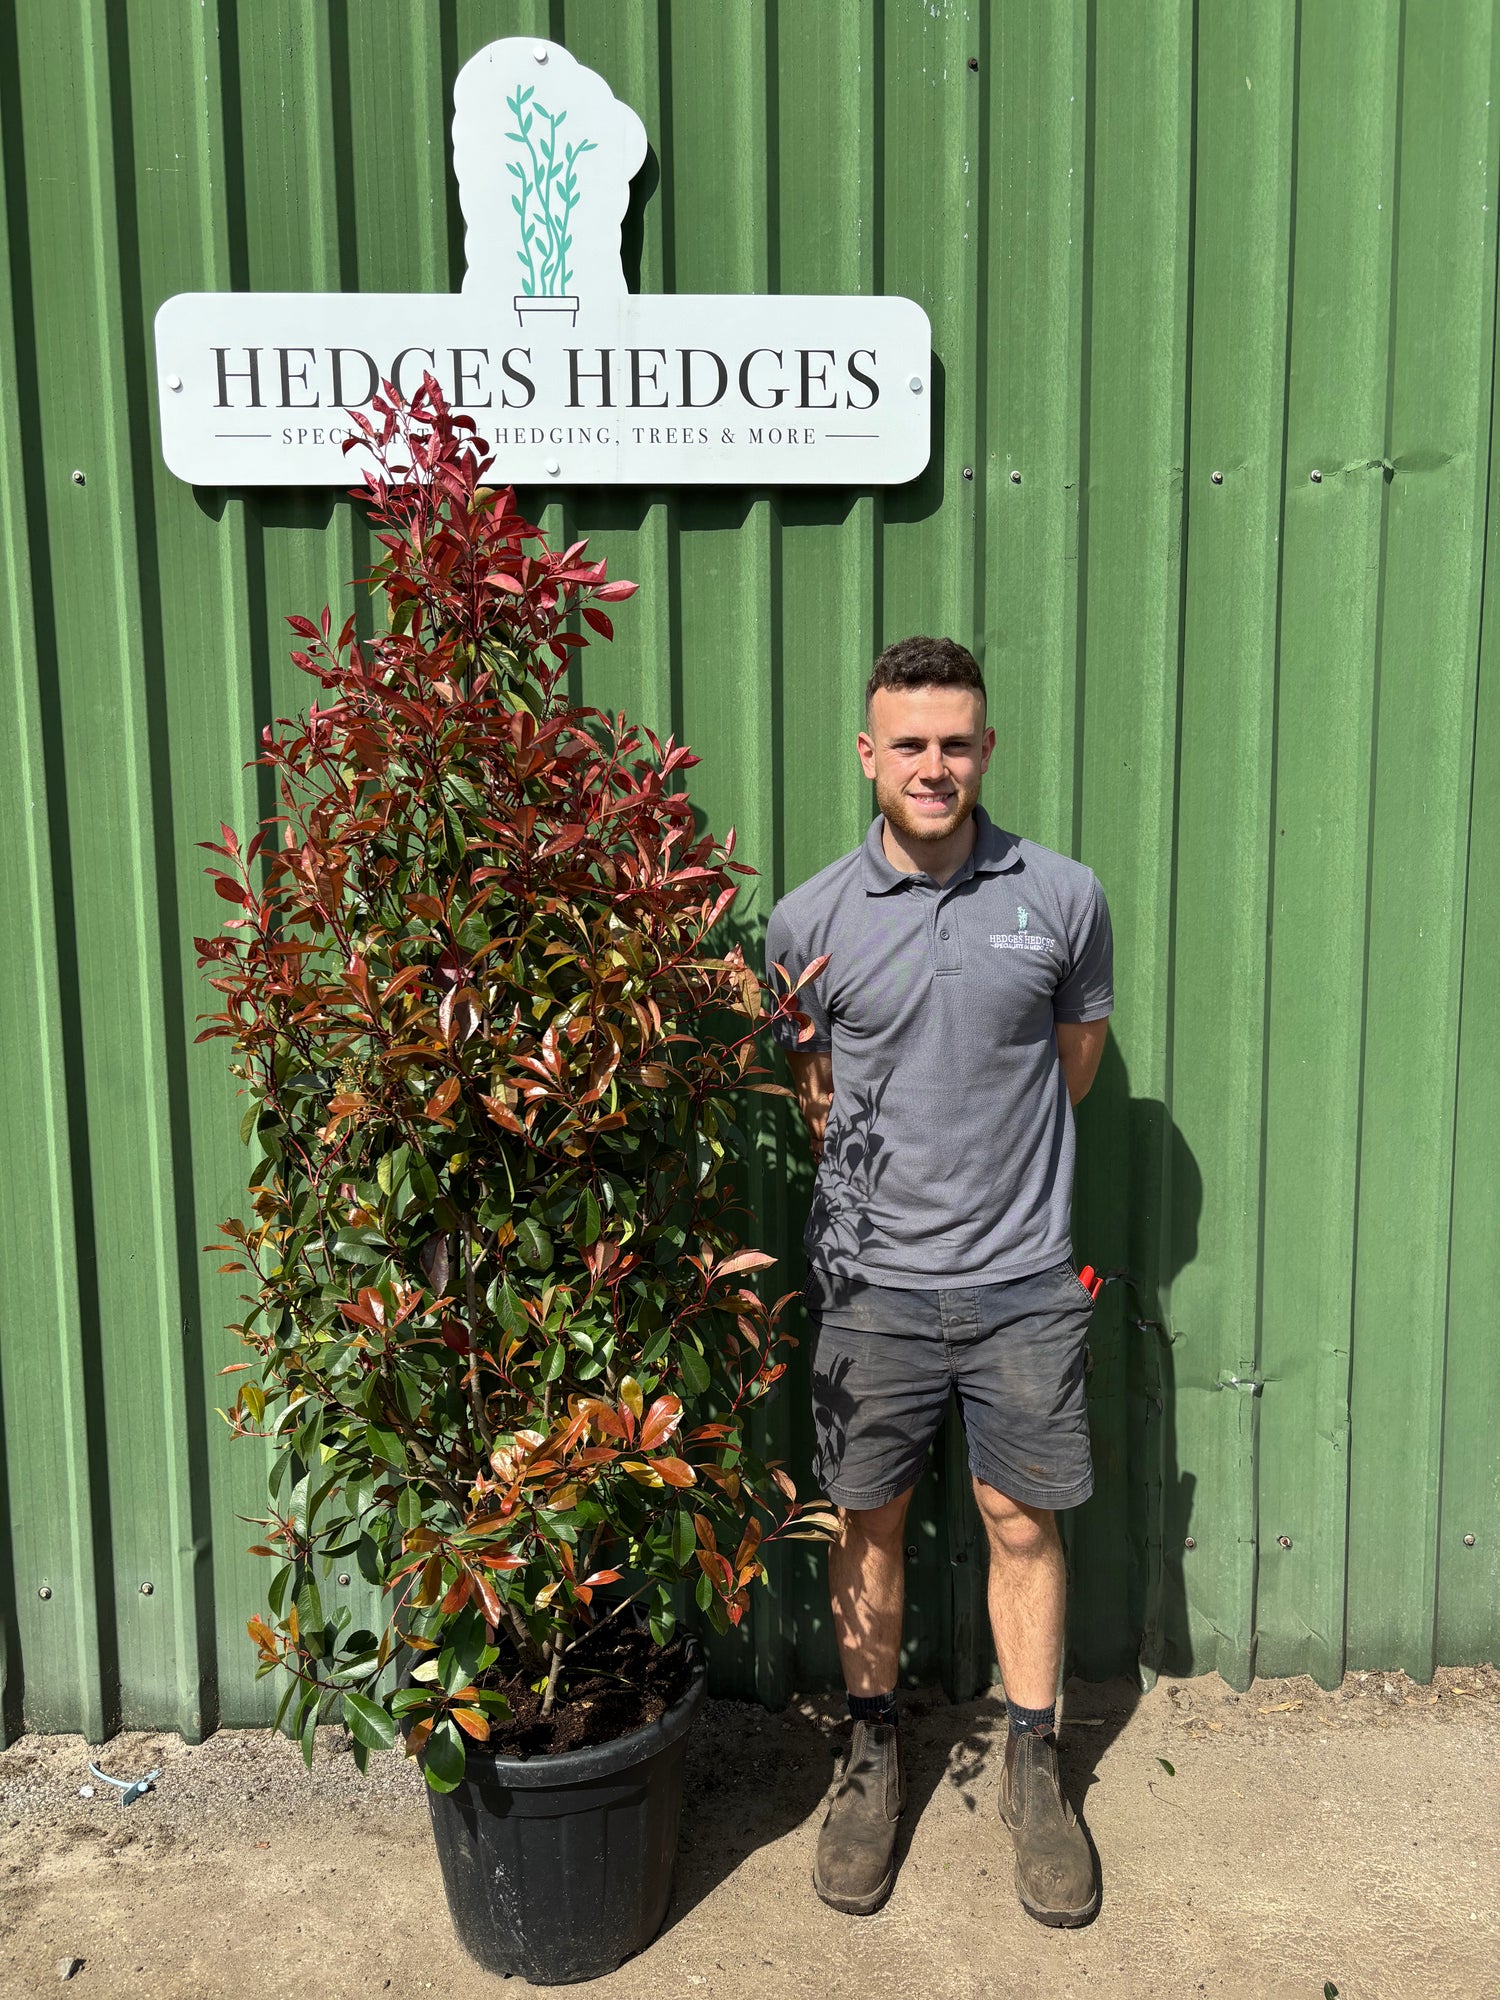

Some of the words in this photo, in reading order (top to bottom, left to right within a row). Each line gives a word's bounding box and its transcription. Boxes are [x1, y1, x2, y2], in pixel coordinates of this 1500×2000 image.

[562, 348, 880, 410] HEDGES
[494, 427, 620, 446] HEDGING,
[632, 427, 708, 444] TREES
[721, 427, 736, 444] &
[748, 427, 816, 445] MORE
